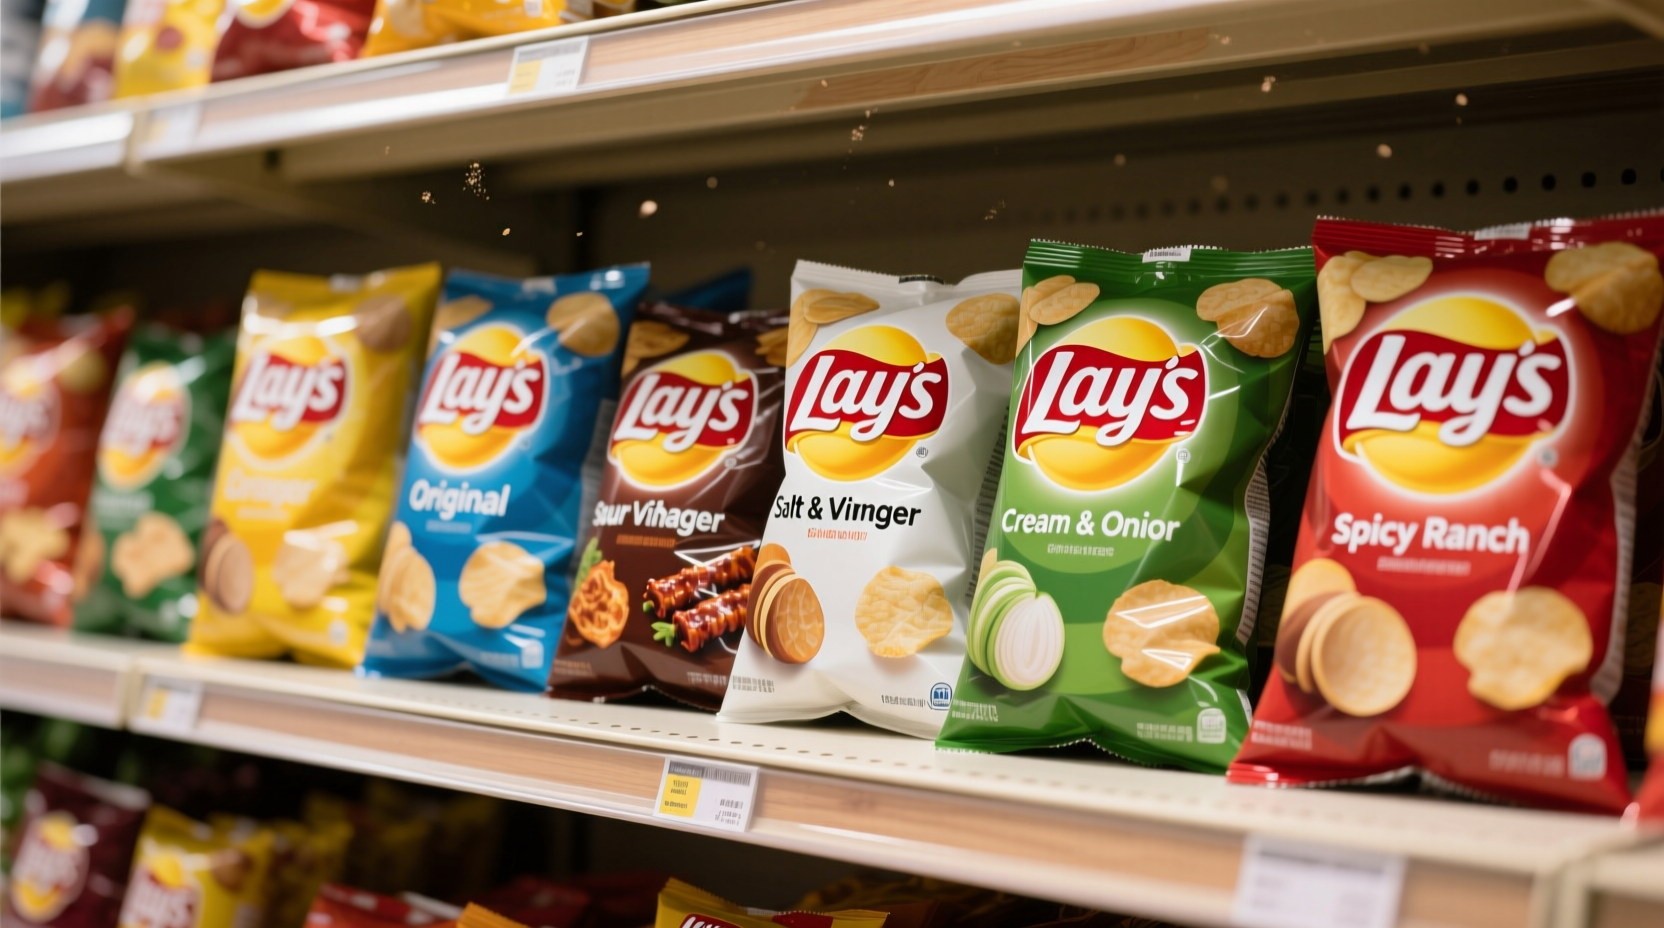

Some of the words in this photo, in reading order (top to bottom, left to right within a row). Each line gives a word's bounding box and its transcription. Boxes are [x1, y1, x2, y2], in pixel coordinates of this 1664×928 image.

[230, 351, 345, 432] Lay's
[417, 352, 541, 436] Lay's
[613, 372, 749, 453] Lay's
[789, 355, 942, 442] Lay's
[1021, 351, 1199, 447] Lay's
[1346, 334, 1562, 447] Lay's
[409, 478, 511, 521] Original
[774, 494, 805, 520] Salt
[807, 496, 824, 521] &
[1001, 508, 1071, 534] Cream
[1076, 510, 1095, 536] &
[1101, 510, 1181, 542] Onior
[1331, 512, 1419, 557] Spicy
[1422, 516, 1530, 555] Ranch
